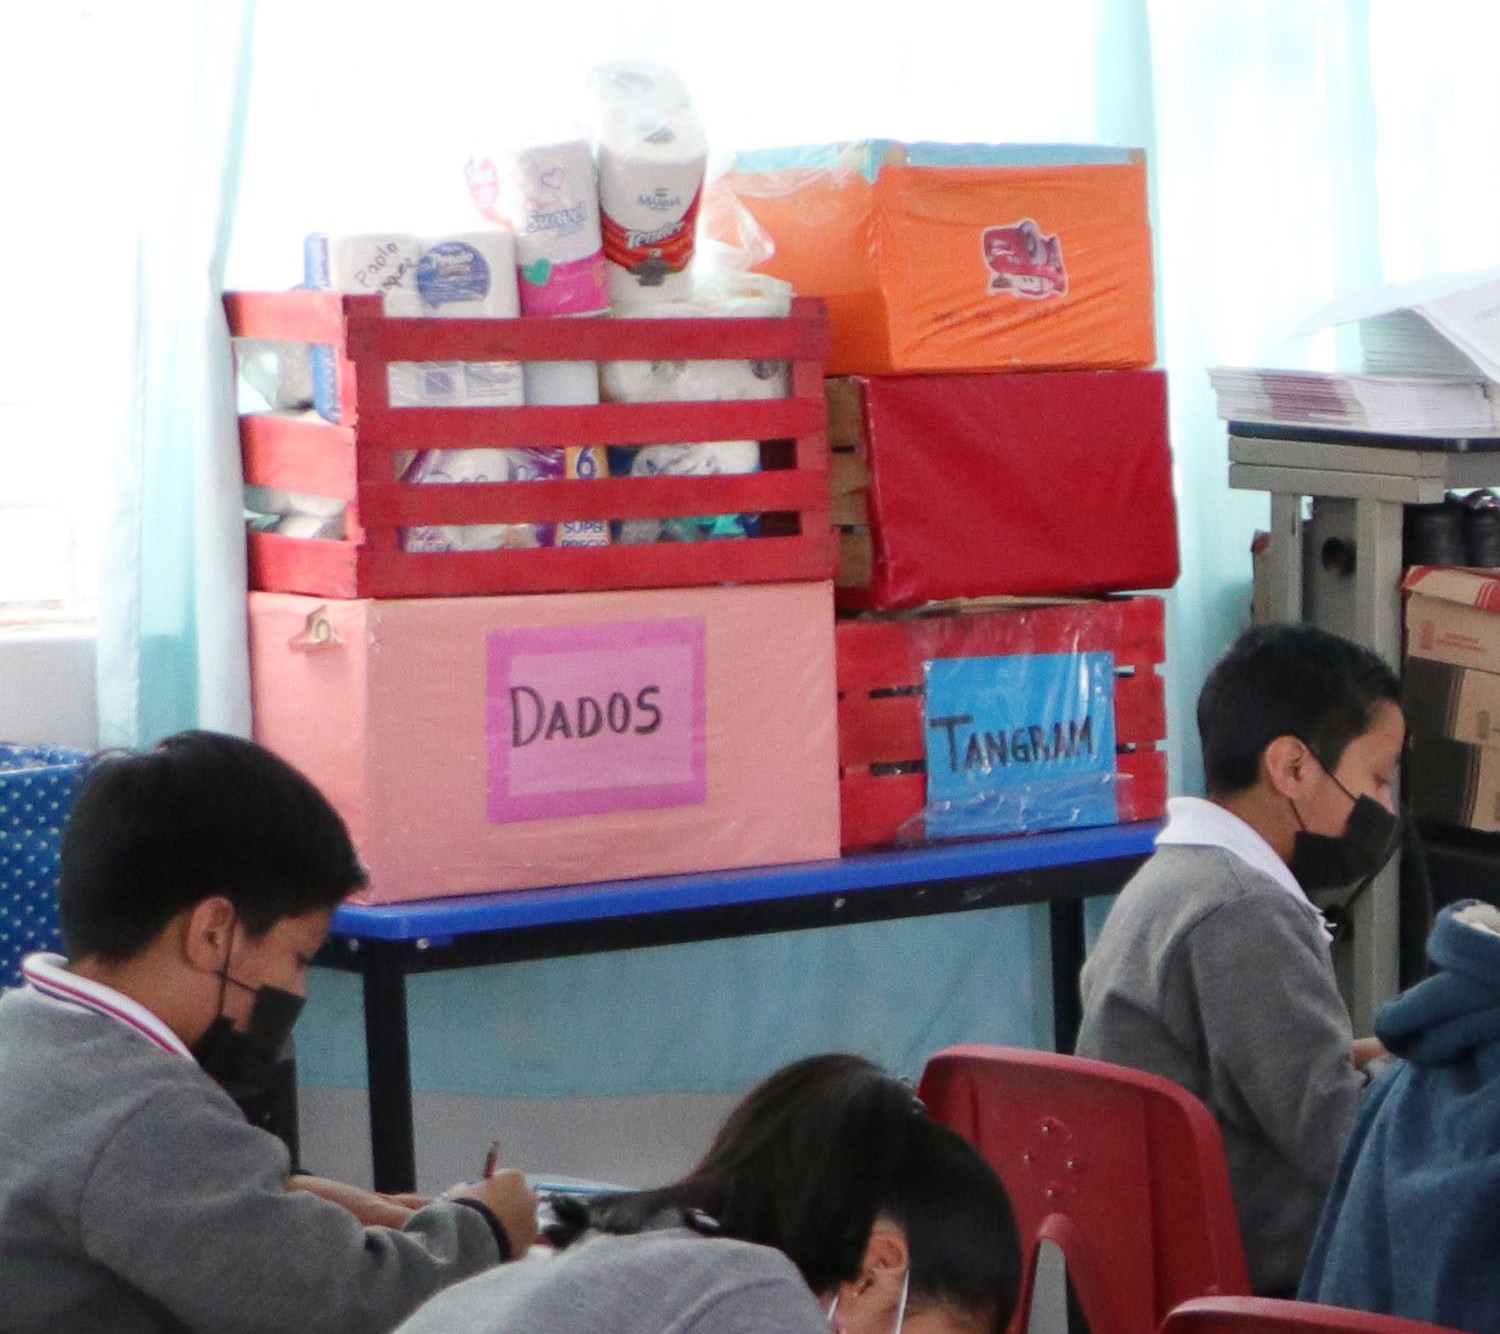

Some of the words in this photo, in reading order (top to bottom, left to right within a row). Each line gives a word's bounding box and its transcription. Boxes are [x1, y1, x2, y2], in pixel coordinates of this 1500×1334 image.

[575, 446, 598, 480] 6
[510, 685, 663, 747] DADOS
[928, 712, 1094, 773] TANGRAM
